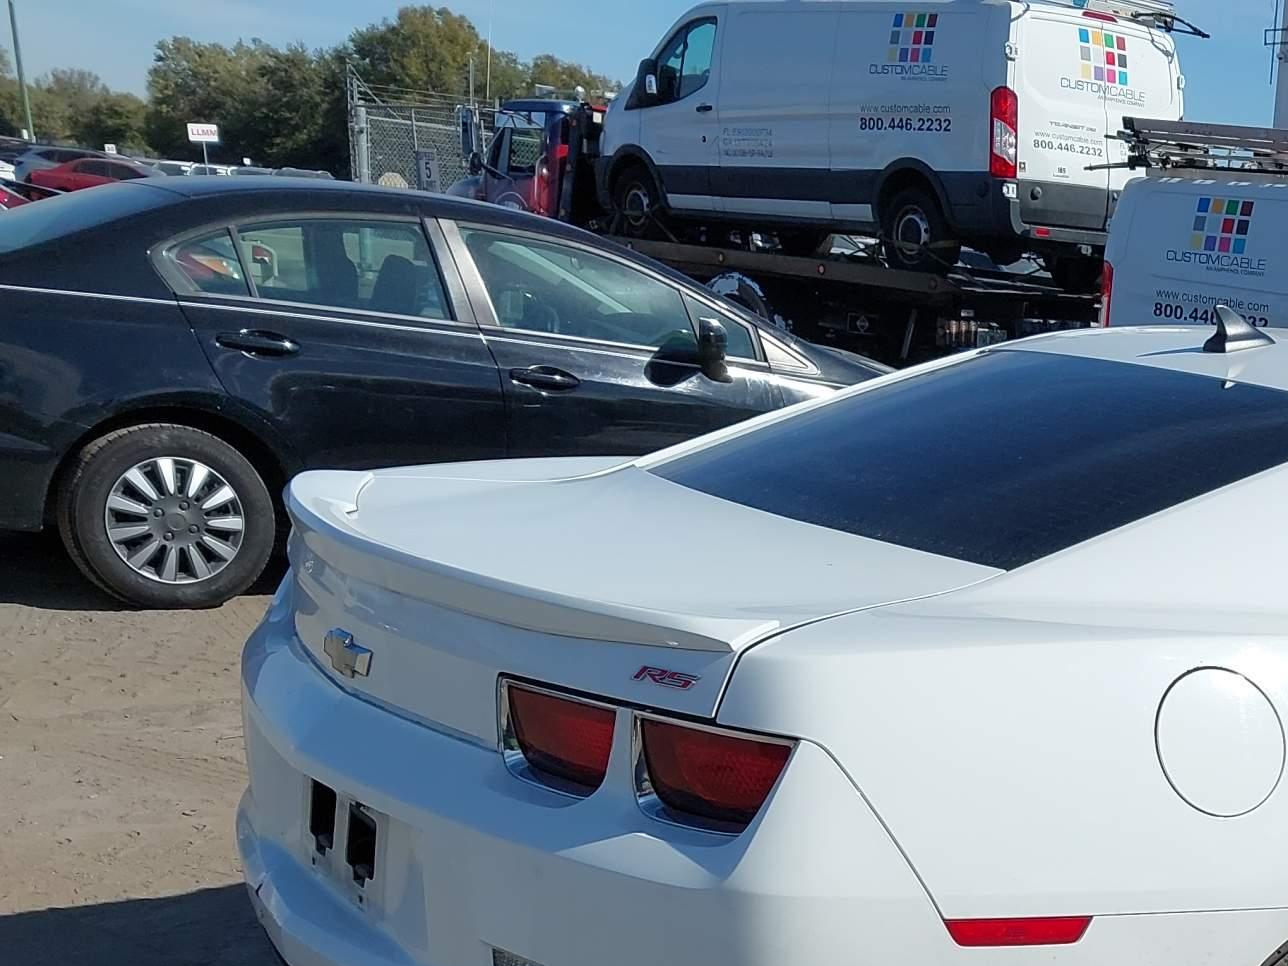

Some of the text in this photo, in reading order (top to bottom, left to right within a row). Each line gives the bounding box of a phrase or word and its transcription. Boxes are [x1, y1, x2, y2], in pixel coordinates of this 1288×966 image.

[869, 64, 949, 76] CUSTOMCABLE
[1060, 77, 1145, 102] CUSTOMCABLE
[860, 103, 951, 114] www.customcable.com
[860, 117, 952, 132] 800.446.2232
[1033, 139, 1103, 158] 800.446.2232
[424, 161, 432, 179] 5
[1166, 250, 1267, 271] CUSTOMCABLE
[1156, 289, 1269, 313] www.customcable.com
[631, 665, 701, 690] RS
